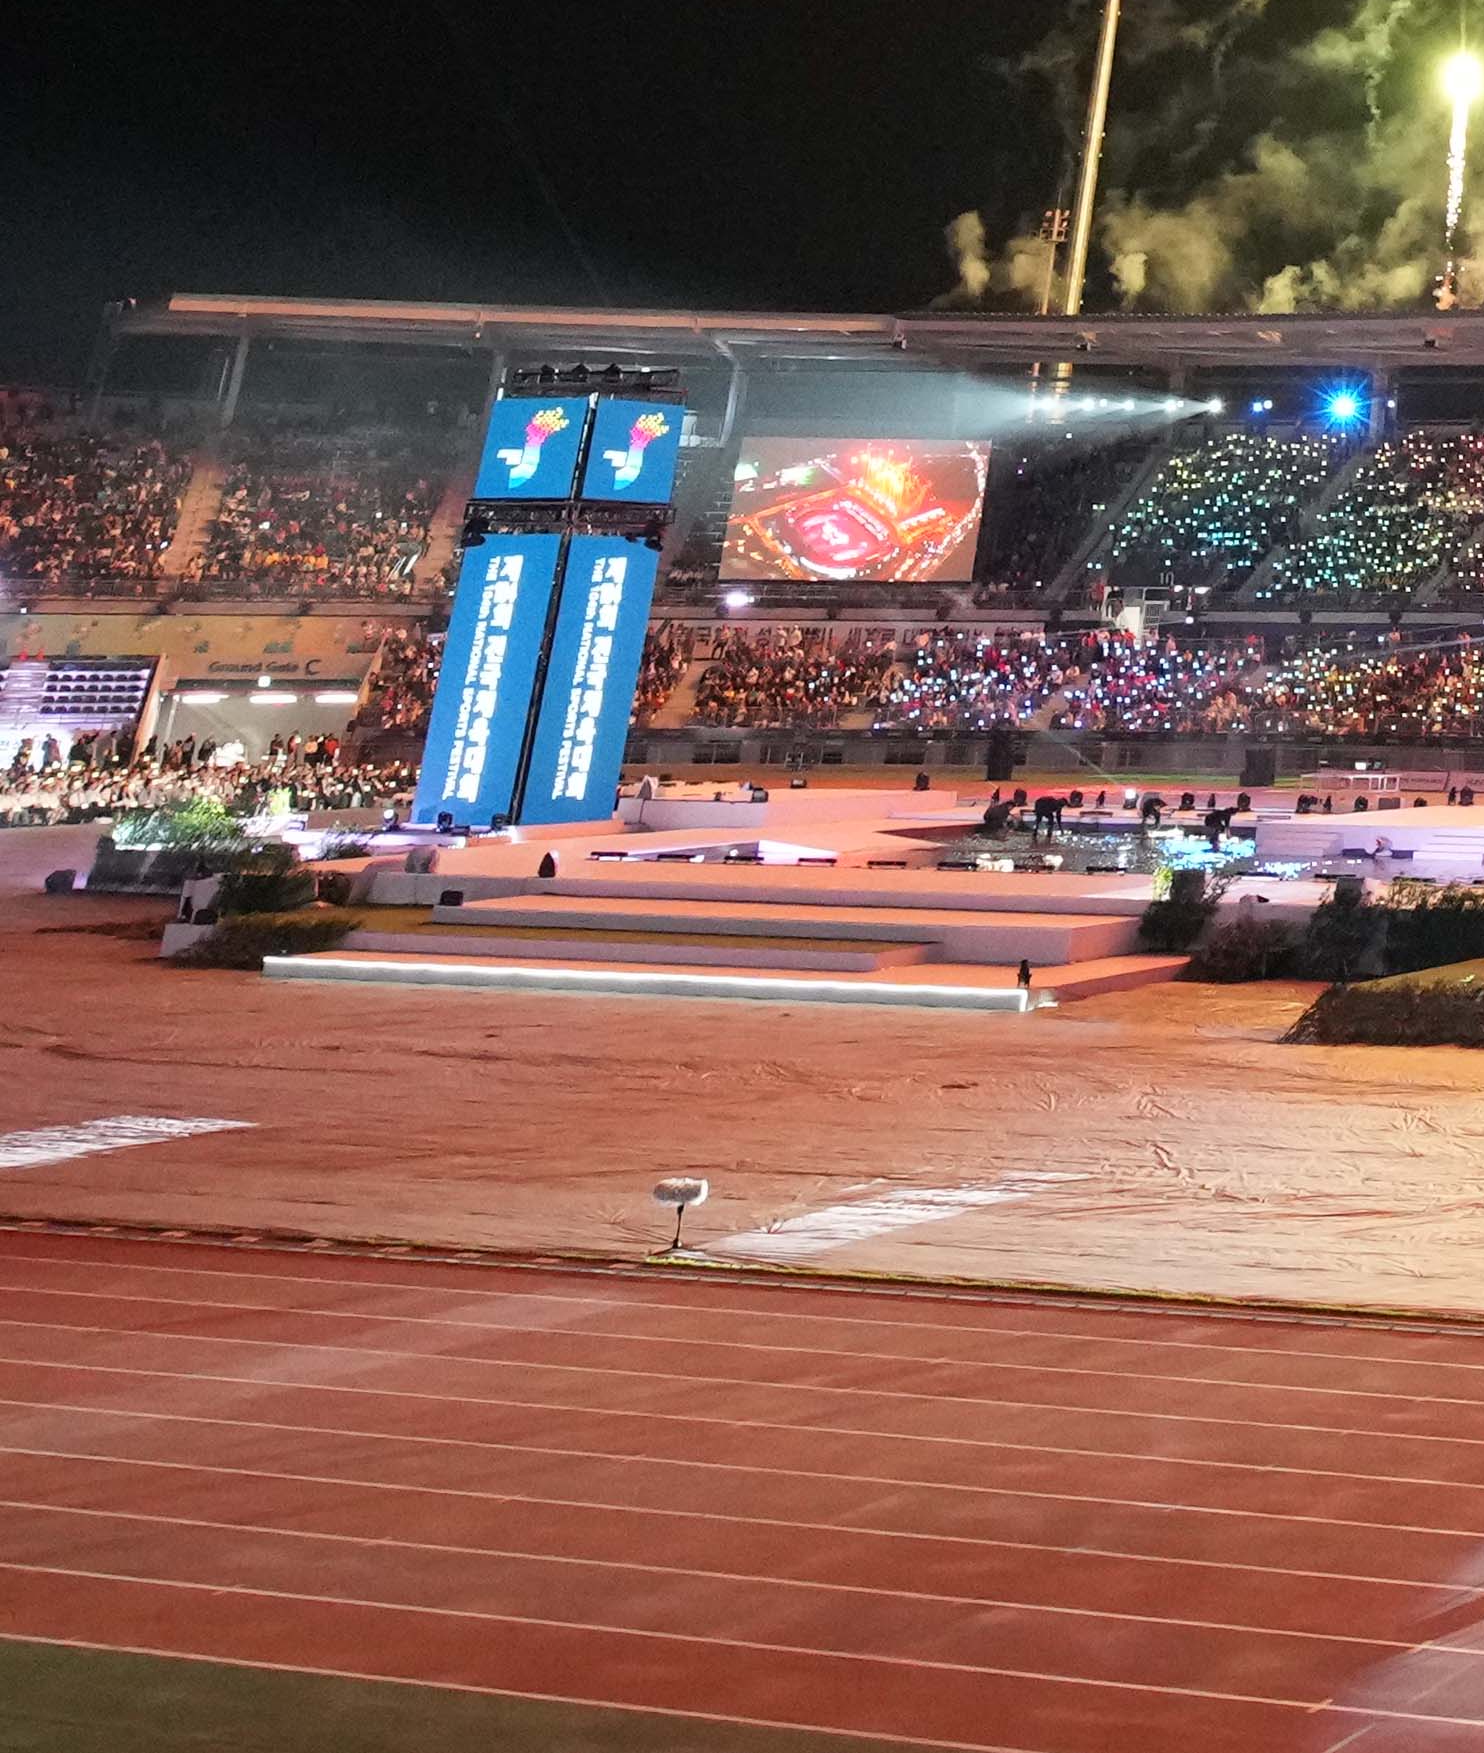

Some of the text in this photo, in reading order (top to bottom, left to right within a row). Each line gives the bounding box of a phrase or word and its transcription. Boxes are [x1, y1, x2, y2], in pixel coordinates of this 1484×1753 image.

[304, 658, 322, 676] C
[464, 621, 488, 688] NATIONAL
[572, 621, 595, 688] NATIONAL
[454, 687, 475, 739] SPORTS
[562, 687, 582, 738] SPORTS
[442, 740, 464, 801] FESTIVAL
[551, 740, 572, 801] FESTIVAL
